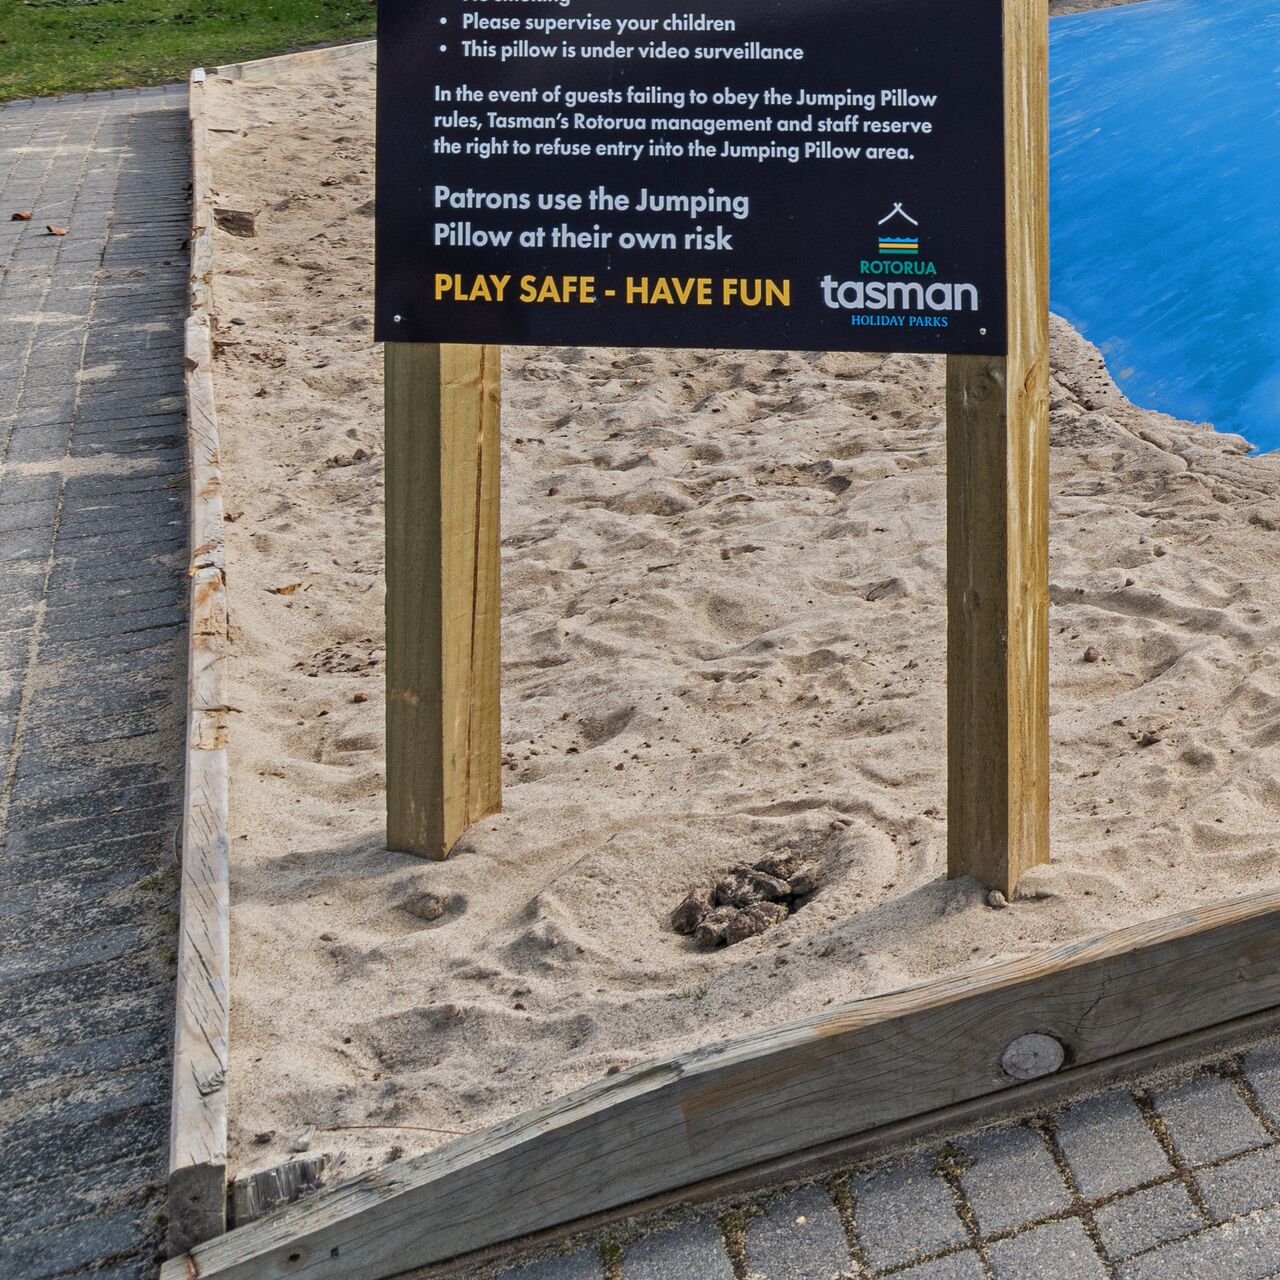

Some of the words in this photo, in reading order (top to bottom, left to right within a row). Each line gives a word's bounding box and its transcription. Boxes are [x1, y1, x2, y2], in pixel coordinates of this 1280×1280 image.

[462, 11, 521, 30] Please
[525, 12, 612, 35] supervise
[615, 18, 659, 36] your
[662, 12, 736, 32] children
[461, 39, 497, 58] This
[501, 39, 558, 62] pillow
[562, 40, 577, 58] is
[580, 40, 635, 59] under
[637, 40, 690, 59] video
[694, 41, 804, 60] surveillance
[434, 85, 452, 102] In
[455, 84, 484, 102] the
[487, 87, 539, 103] event
[541, 85, 562, 103] of
[564, 88, 623, 108] guests
[626, 85, 685, 109] failing
[688, 89, 708, 105] to
[712, 86, 760, 110] obey
[763, 87, 793, 106] the
[795, 88, 876, 111] Jumping
[880, 88, 938, 107] Pillow
[434, 111, 483, 131] rules,
[486, 111, 570, 129] Tasman's
[573, 112, 647, 130] Rotorua
[651, 116, 773, 136] management
[776, 113, 813, 132] and
[817, 114, 860, 133] staff
[863, 120, 933, 134] reserve
[433, 136, 462, 154] the
[466, 136, 510, 159] right
[512, 139, 531, 155] to
[535, 137, 592, 156] refuse
[595, 141, 645, 161] entry
[648, 138, 684, 157] into
[687, 139, 717, 158] the
[720, 140, 800, 163] Jumping
[804, 140, 862, 159] Pillow
[865, 147, 915, 160] area.
[434, 185, 531, 210] Patrons
[537, 193, 583, 211] use
[588, 185, 630, 212] the
[635, 187, 749, 220] Jumping
[434, 221, 513, 247] Pillow
[519, 227, 546, 248] at
[551, 222, 613, 249] their
[618, 232, 677, 250] own
[684, 225, 734, 251] risk
[860, 260, 937, 275] ROTORUA
[434, 273, 512, 302] PLAY
[519, 274, 597, 304] SAFE
[626, 276, 713, 305] HAVE
[722, 278, 791, 307] FUN
[820, 272, 979, 311] tasman
[851, 314, 906, 326] HOLIDAY
[909, 315, 948, 328] PARKS
